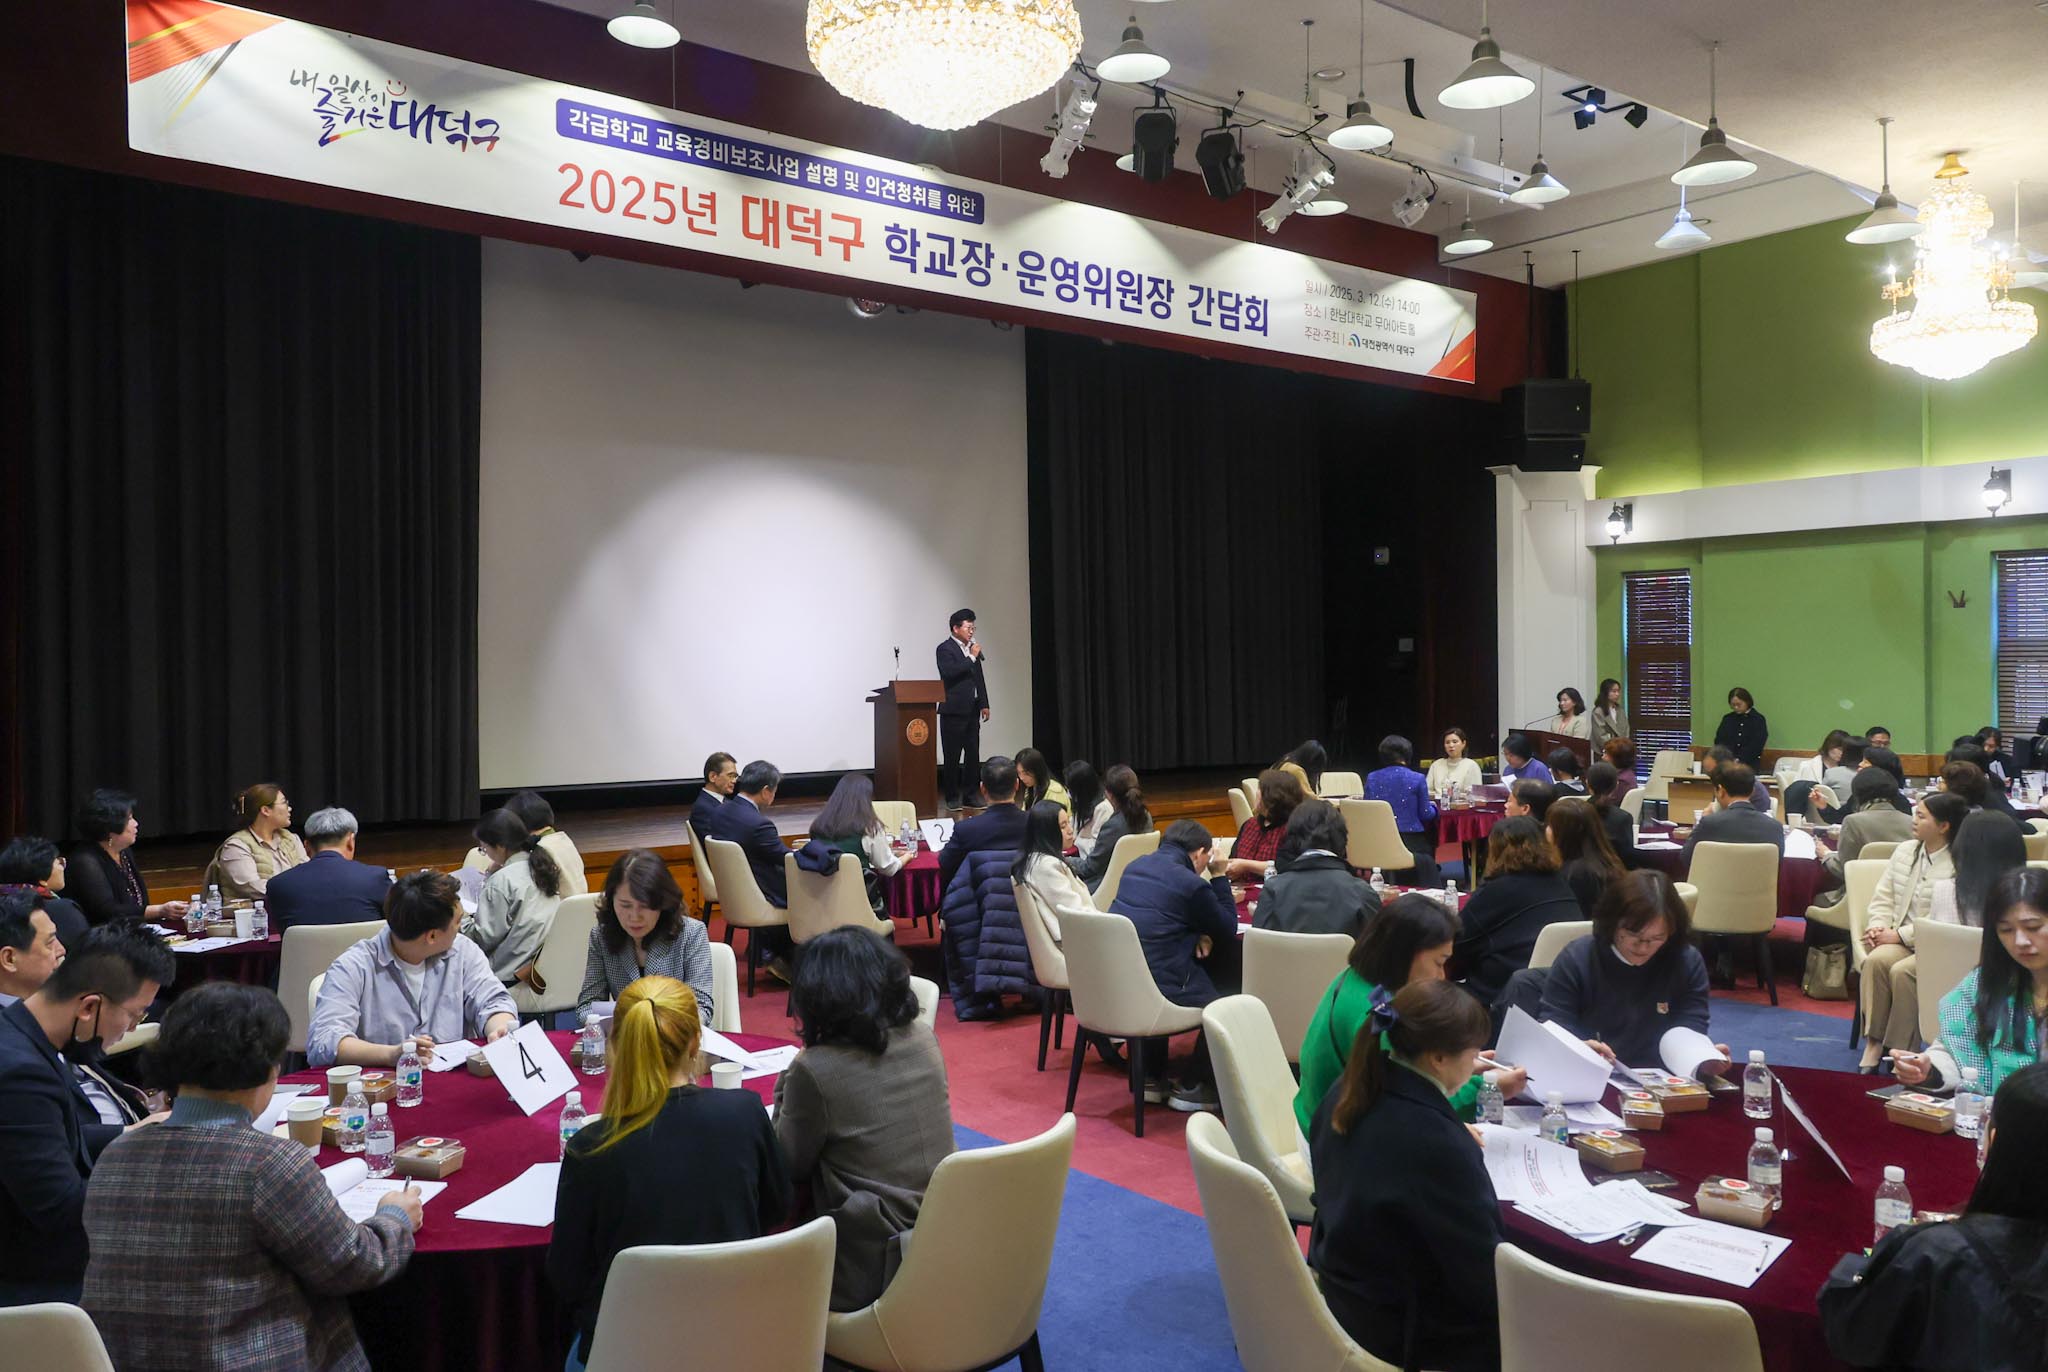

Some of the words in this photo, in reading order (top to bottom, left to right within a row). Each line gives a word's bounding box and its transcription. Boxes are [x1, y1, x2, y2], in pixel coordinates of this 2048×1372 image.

[289, 68, 320, 94] 내
[329, 74, 386, 107] 일상이
[313, 87, 385, 147] 즐거운
[388, 99, 501, 153] 대덕구
[568, 107, 649, 147] 각급학교
[655, 127, 800, 181] 교육경비보조사업
[805, 161, 839, 188] 설명
[844, 169, 860, 193] 및
[864, 175, 943, 211] 의견청취를
[946, 192, 977, 217] 위한
[557, 161, 718, 237] 2025년
[741, 194, 865, 263] 대덕구
[1187, 283, 1269, 337] 간담회
[1303, 303, 1322, 318] 장소
[1330, 308, 1372, 328] 한남대학교
[1305, 280, 1322, 296] 일시
[1329, 284, 1355, 302] 2025.
[1357, 290, 1366, 304] 3.
[1397, 299, 1421, 316] 14:00
[1361, 338, 1395, 353] 대전광역시
[1396, 345, 1415, 357] 대덕구
[933, 823, 950, 843] 2
[518, 1041, 546, 1083] 4
